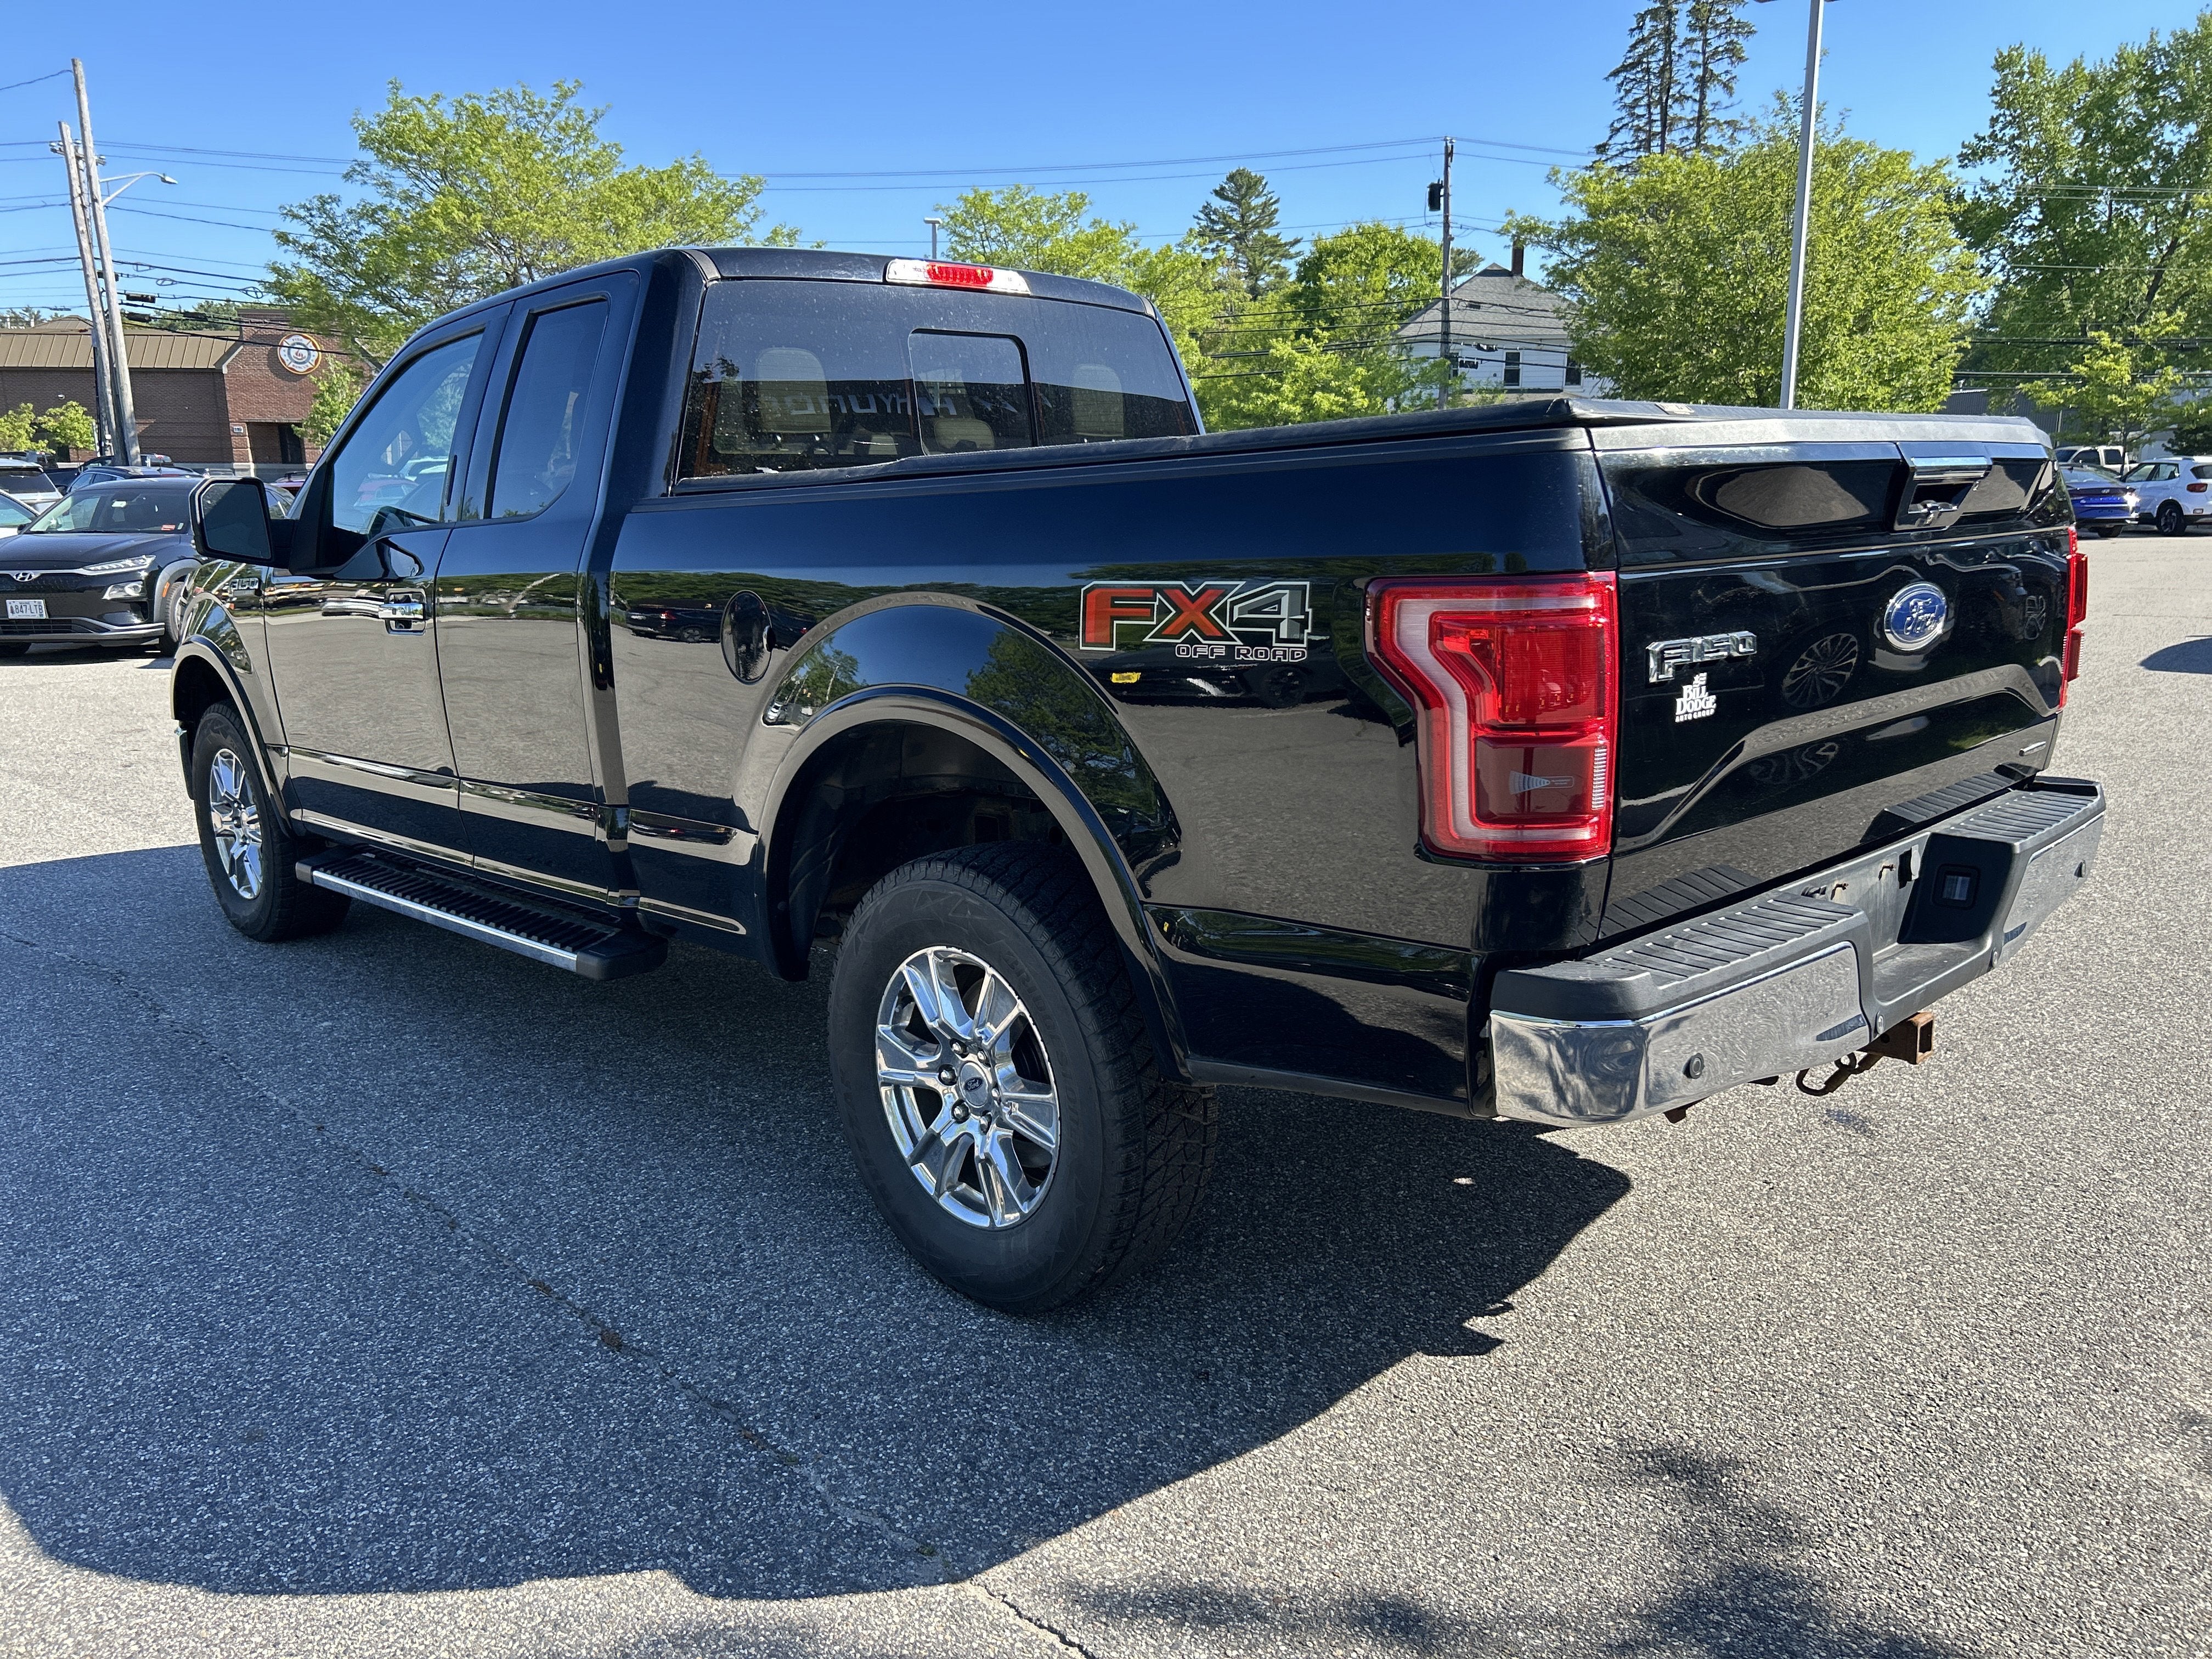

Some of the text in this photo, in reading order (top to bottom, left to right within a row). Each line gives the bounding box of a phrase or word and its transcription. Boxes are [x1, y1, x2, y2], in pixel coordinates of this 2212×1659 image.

[1080, 581, 1312, 651] FX4
[1175, 644, 1307, 662] OFF ROAD
[1682, 685, 1709, 701] BILL
[1675, 695, 1717, 715] DODGE
[1675, 708, 1714, 723] AUTO GROUP
[967, 1079, 979, 1091] Ford
